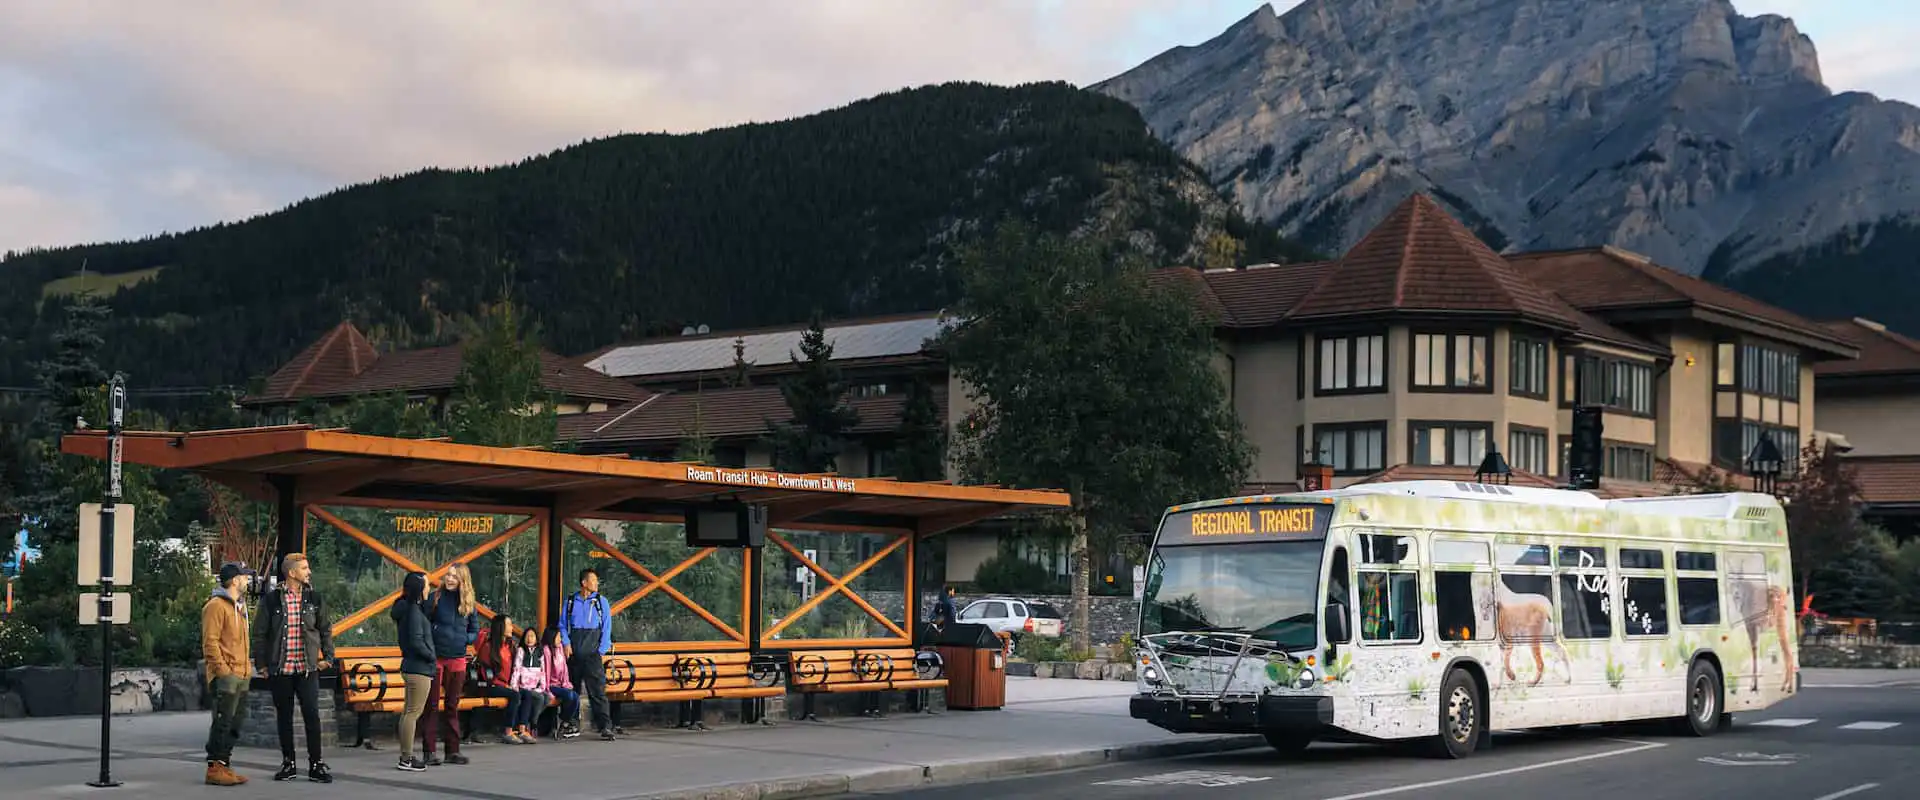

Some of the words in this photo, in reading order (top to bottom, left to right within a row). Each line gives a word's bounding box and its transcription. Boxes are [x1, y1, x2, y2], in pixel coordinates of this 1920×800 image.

[687, 466, 714, 481] Roam
[715, 468, 748, 484] Transit
[750, 471, 769, 485] Hub
[778, 474, 820, 490] Downtown
[821, 477, 835, 490] Elk
[835, 478, 855, 492] West
[1192, 511, 1255, 536] REGIONAL
[1258, 508, 1314, 533] TRANSIT
